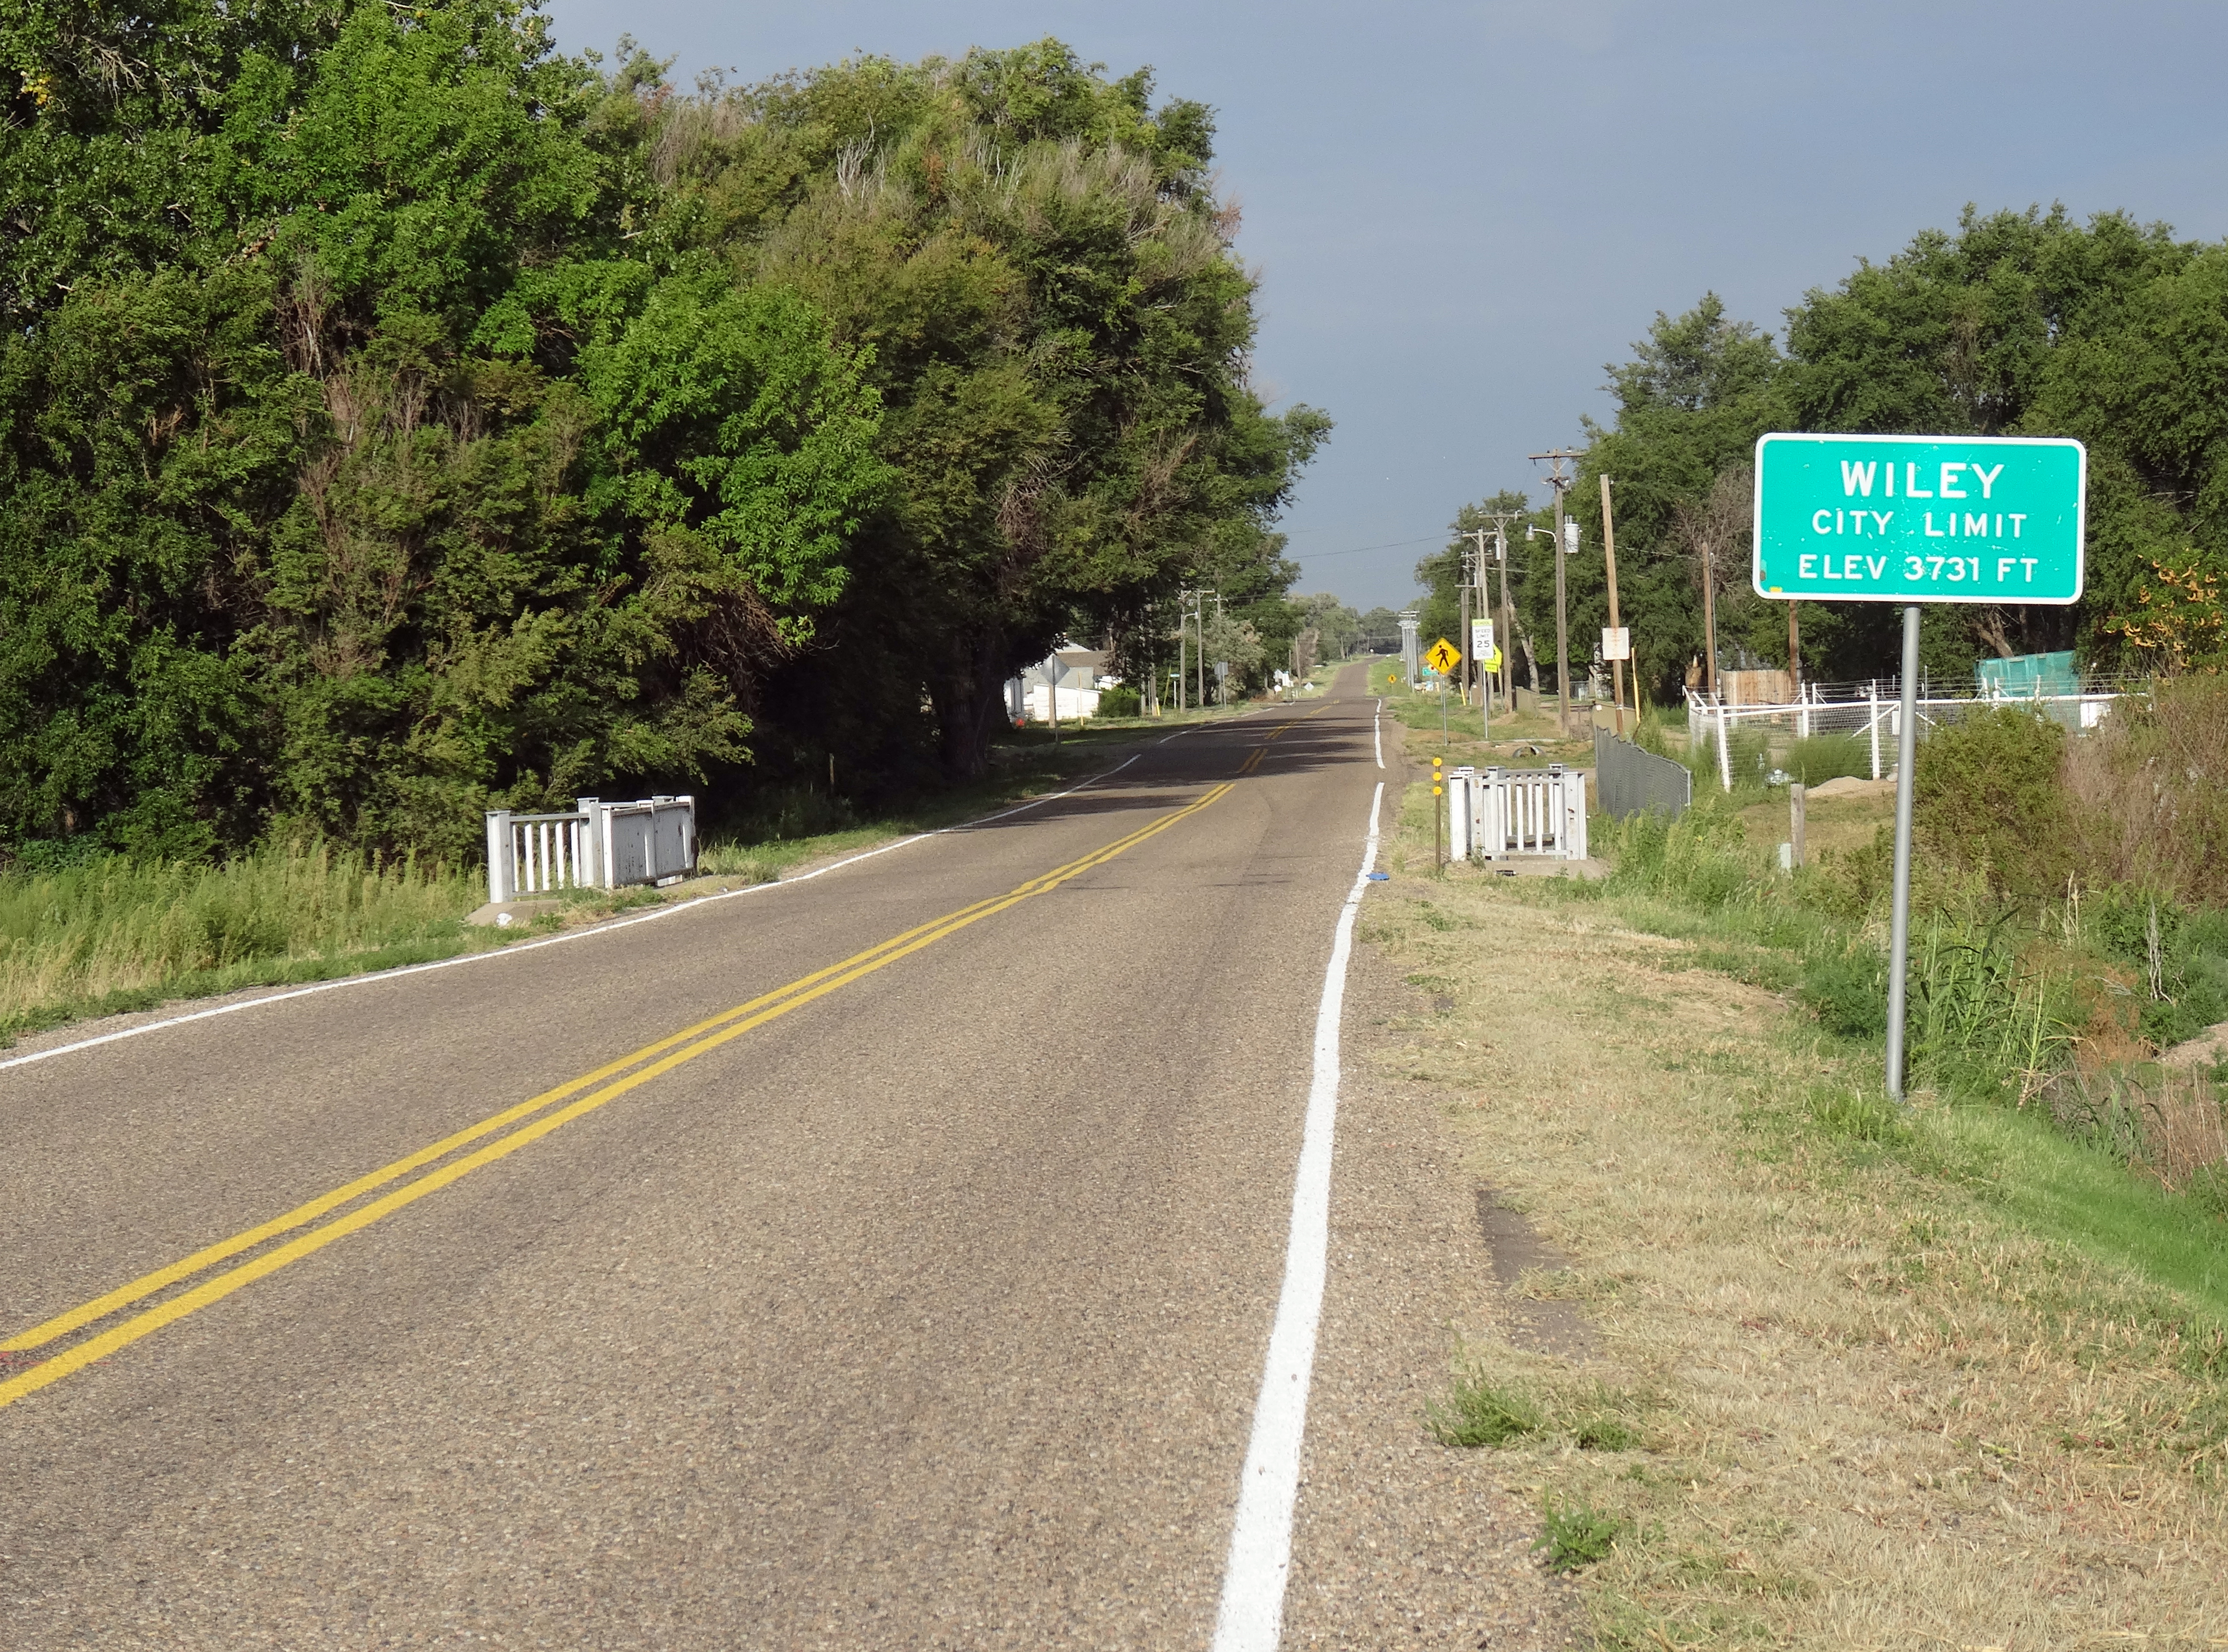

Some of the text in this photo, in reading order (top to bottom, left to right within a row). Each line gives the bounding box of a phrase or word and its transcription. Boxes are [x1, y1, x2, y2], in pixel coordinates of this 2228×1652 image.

[1841, 460, 2004, 498] WILEY
[1812, 509, 2027, 538] CITY LIMIT
[1799, 554, 2038, 583] ELEV 3731 FT
